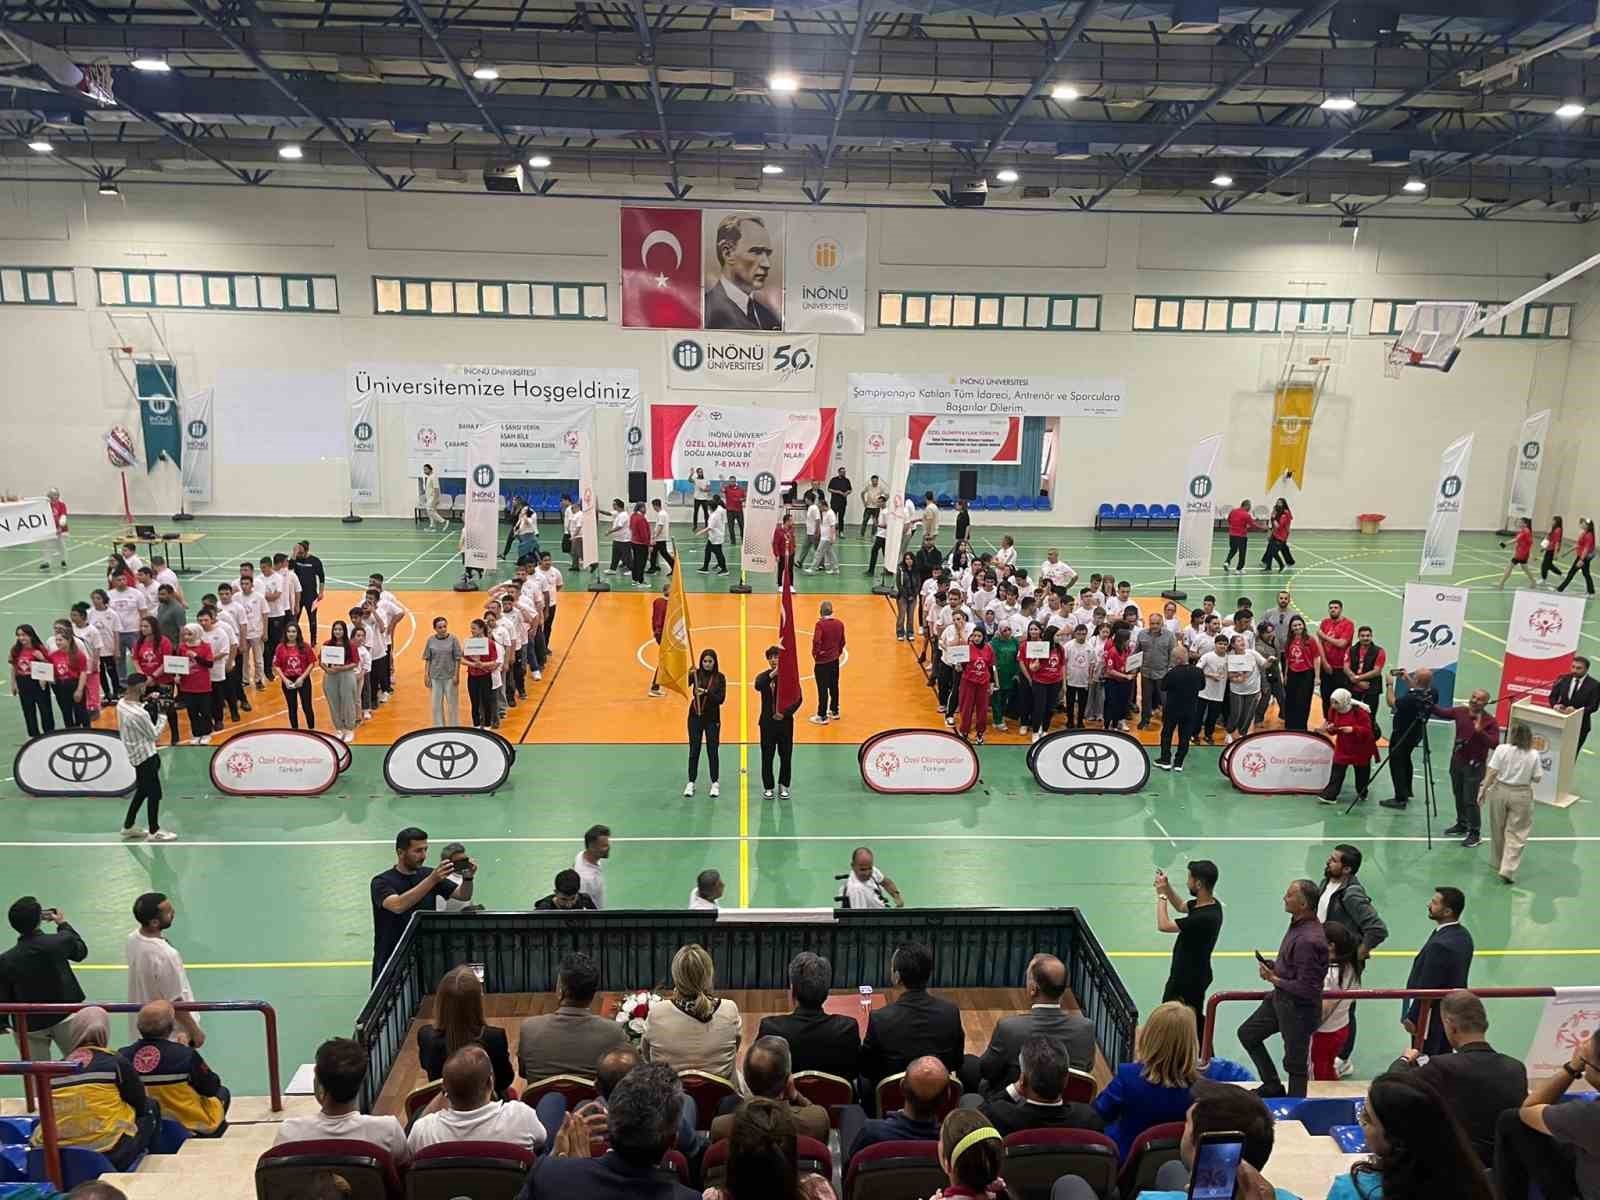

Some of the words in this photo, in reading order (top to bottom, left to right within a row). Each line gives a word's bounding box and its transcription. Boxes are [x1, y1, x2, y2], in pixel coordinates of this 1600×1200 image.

[802, 285, 848, 300] İNÖNÜ
[706, 343, 764, 360] İNÖNÜ
[706, 361, 764, 371] ÜNİVERSİTESİ
[355, 371, 505, 397] Üniversitemize
[513, 379, 631, 402] Hoşgeldiniz
[919, 388, 951, 398] Katılan
[953, 388, 975, 399] Tüm
[1014, 390, 1053, 401] Antrenör
[1056, 393, 1068, 401] ve
[1070, 391, 1120, 403] Sporculara
[945, 402, 987, 414] Başarılar
[685, 440, 705, 448] ÖZEL
[683, 449, 705, 457] DOĞU
[705, 450, 742, 458] ANADOLU
[17, 514, 48, 531] ADI
